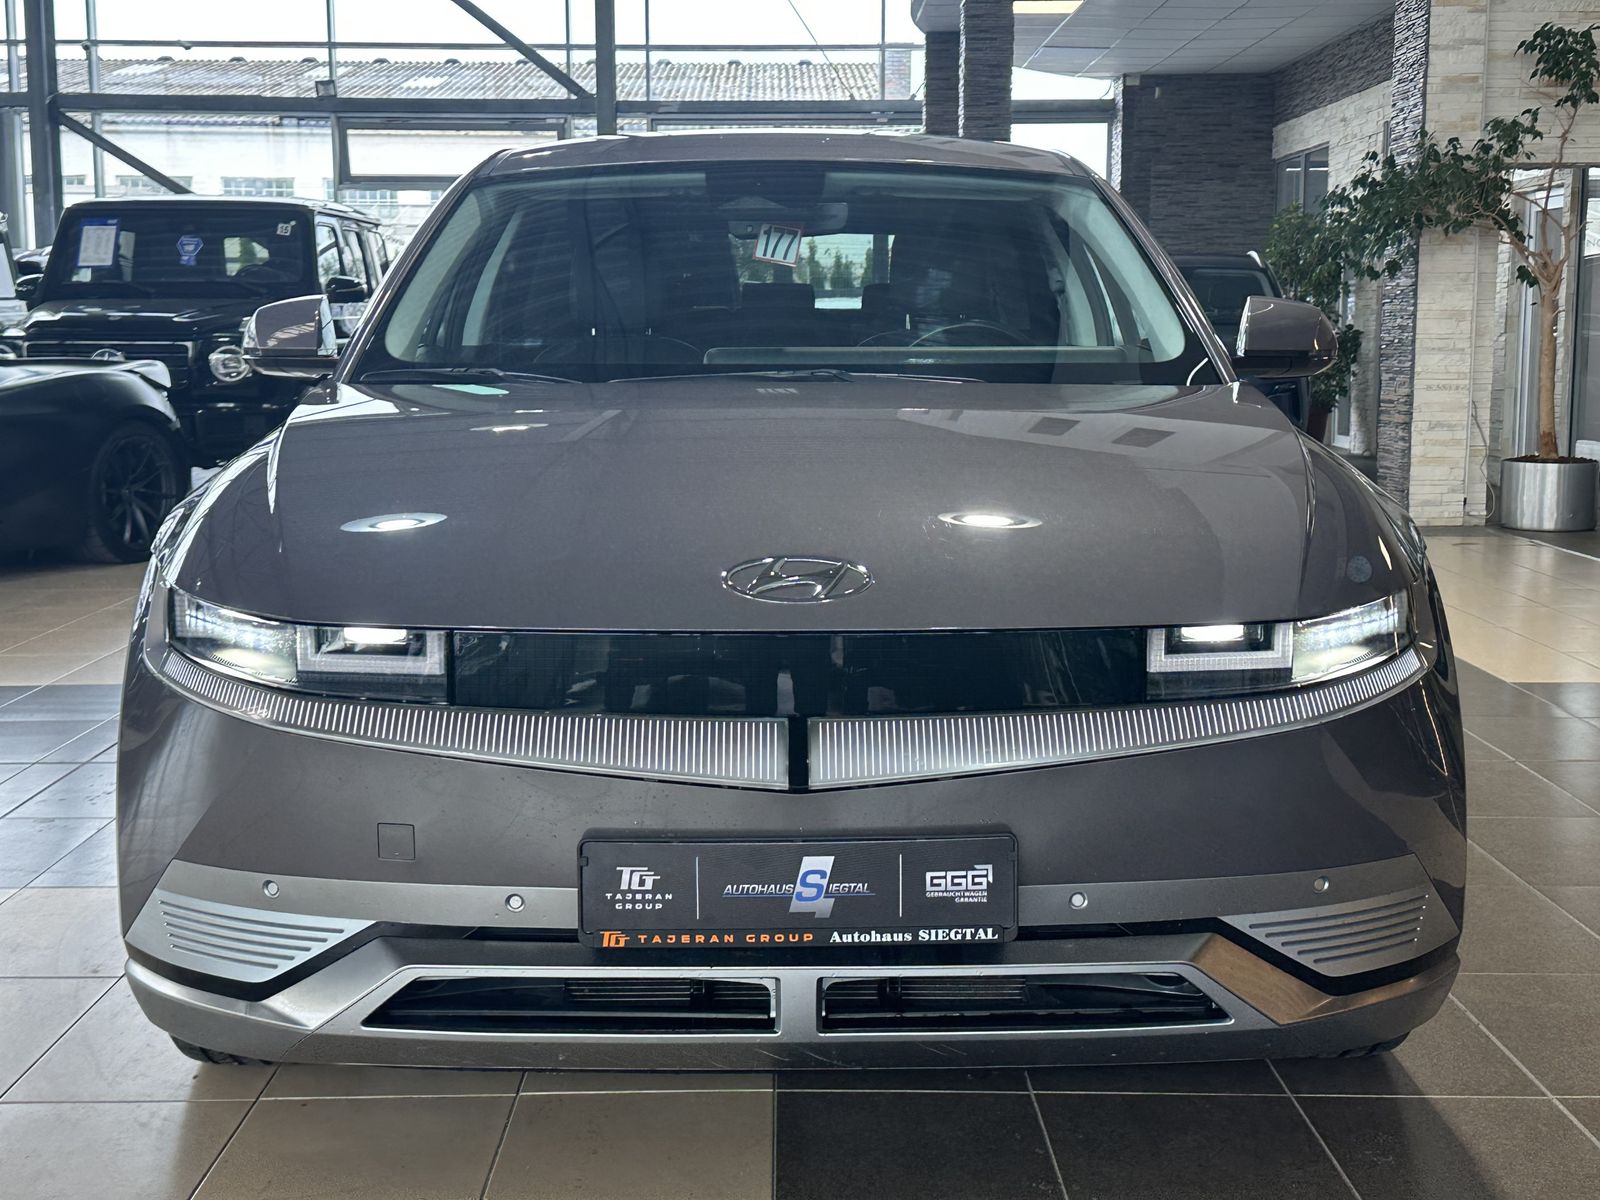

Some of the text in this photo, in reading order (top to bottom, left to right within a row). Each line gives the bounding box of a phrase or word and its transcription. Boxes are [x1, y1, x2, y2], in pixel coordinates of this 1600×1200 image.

[762, 226, 799, 260] 177
[723, 884, 794, 895] AUTOHAUS
[925, 868, 989, 892] GGG
[638, 934, 734, 944] TAJERAN
[746, 933, 814, 943] GROUP
[829, 930, 912, 943] Autohaus
[918, 927, 998, 941] SIEGTAL
